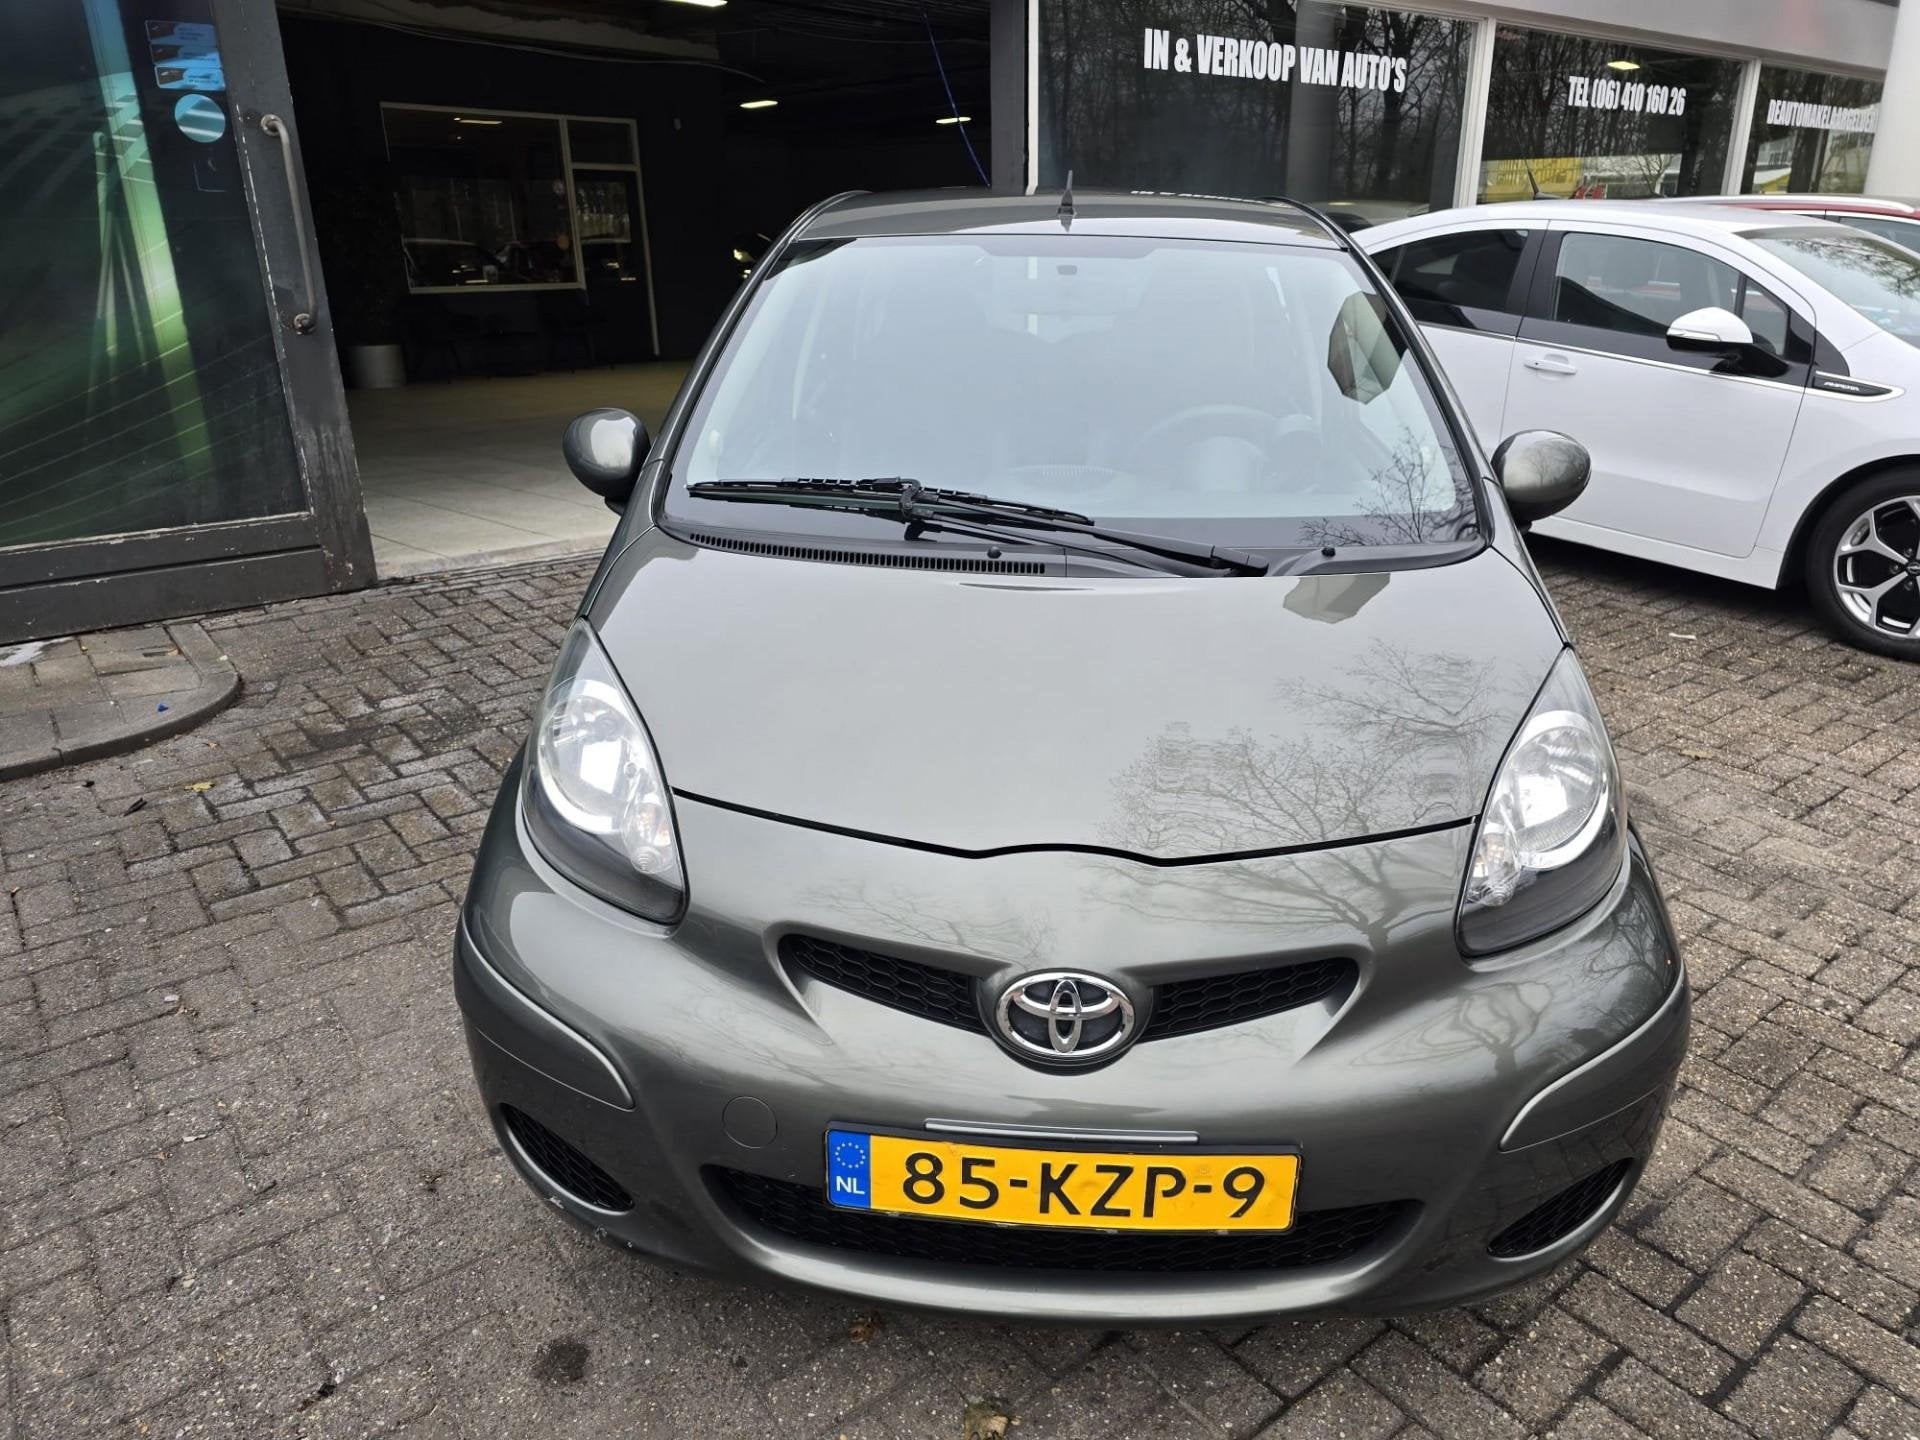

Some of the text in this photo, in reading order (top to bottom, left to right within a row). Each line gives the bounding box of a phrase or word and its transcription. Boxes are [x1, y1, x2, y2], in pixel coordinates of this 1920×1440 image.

[1144, 28, 1407, 93] IN & VERKOOP VAN AUTO'S
[1568, 76, 1687, 116] TEL (06) 410 160 26
[836, 1176, 865, 1195] NL
[902, 1152, 1265, 1218] 85-KZP-9
